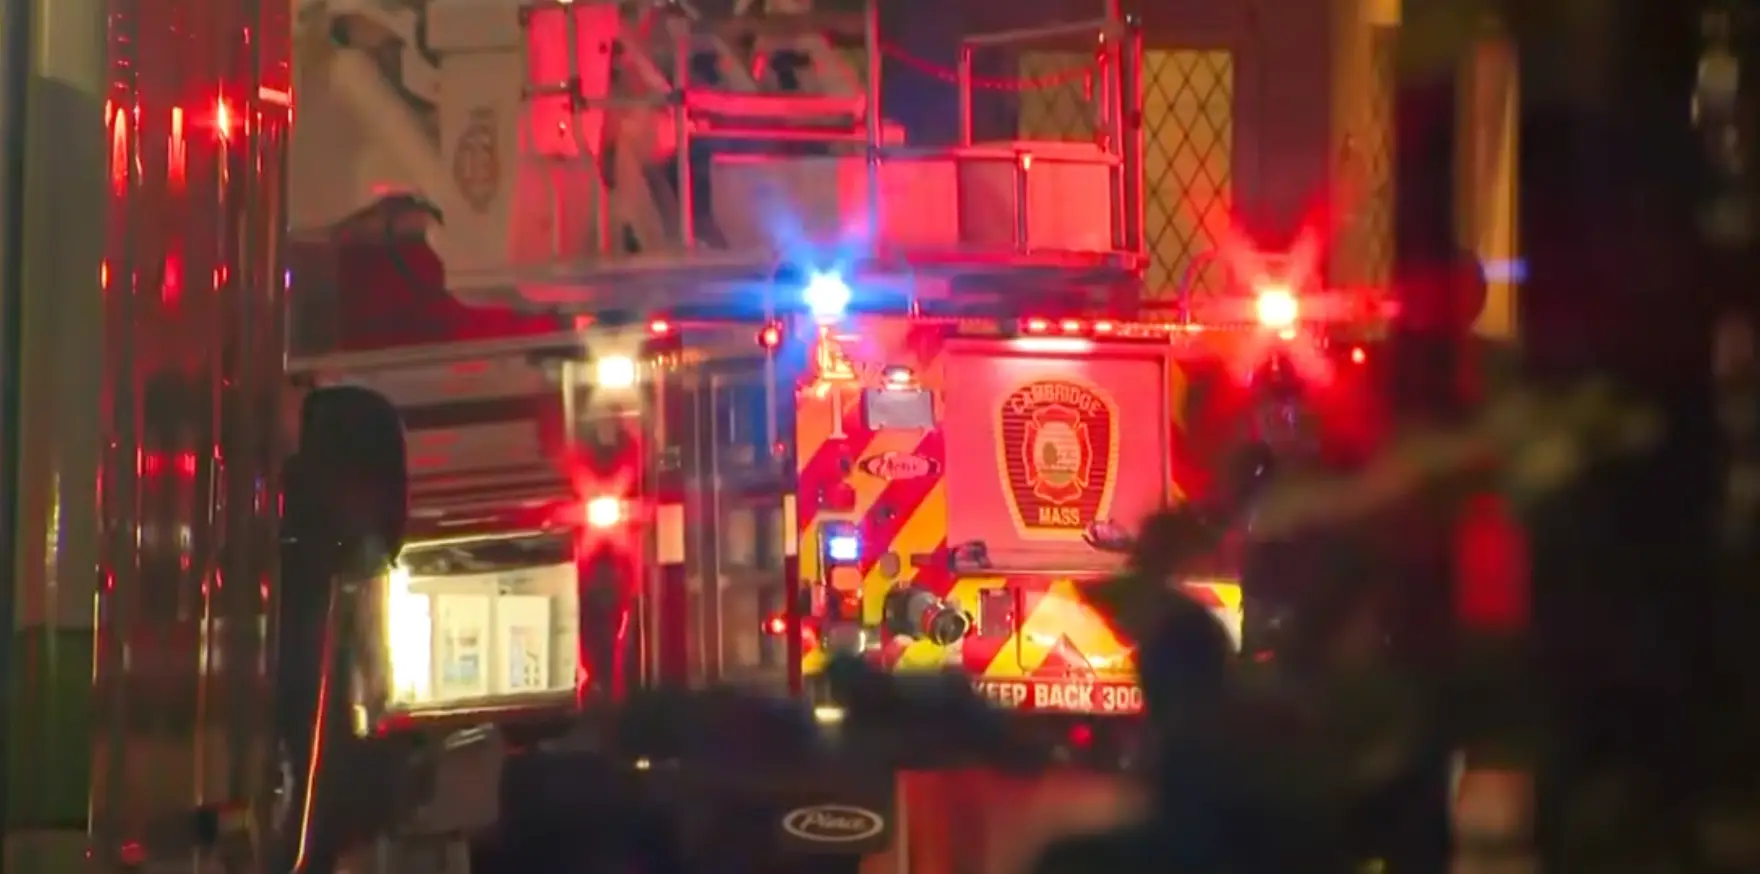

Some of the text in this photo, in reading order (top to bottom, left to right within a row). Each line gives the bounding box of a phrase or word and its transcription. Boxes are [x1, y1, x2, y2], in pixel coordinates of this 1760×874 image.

[1011, 383, 1101, 417] CAMBRIDGE
[1039, 507, 1081, 525] MASS
[1034, 683, 1093, 710] BACK
